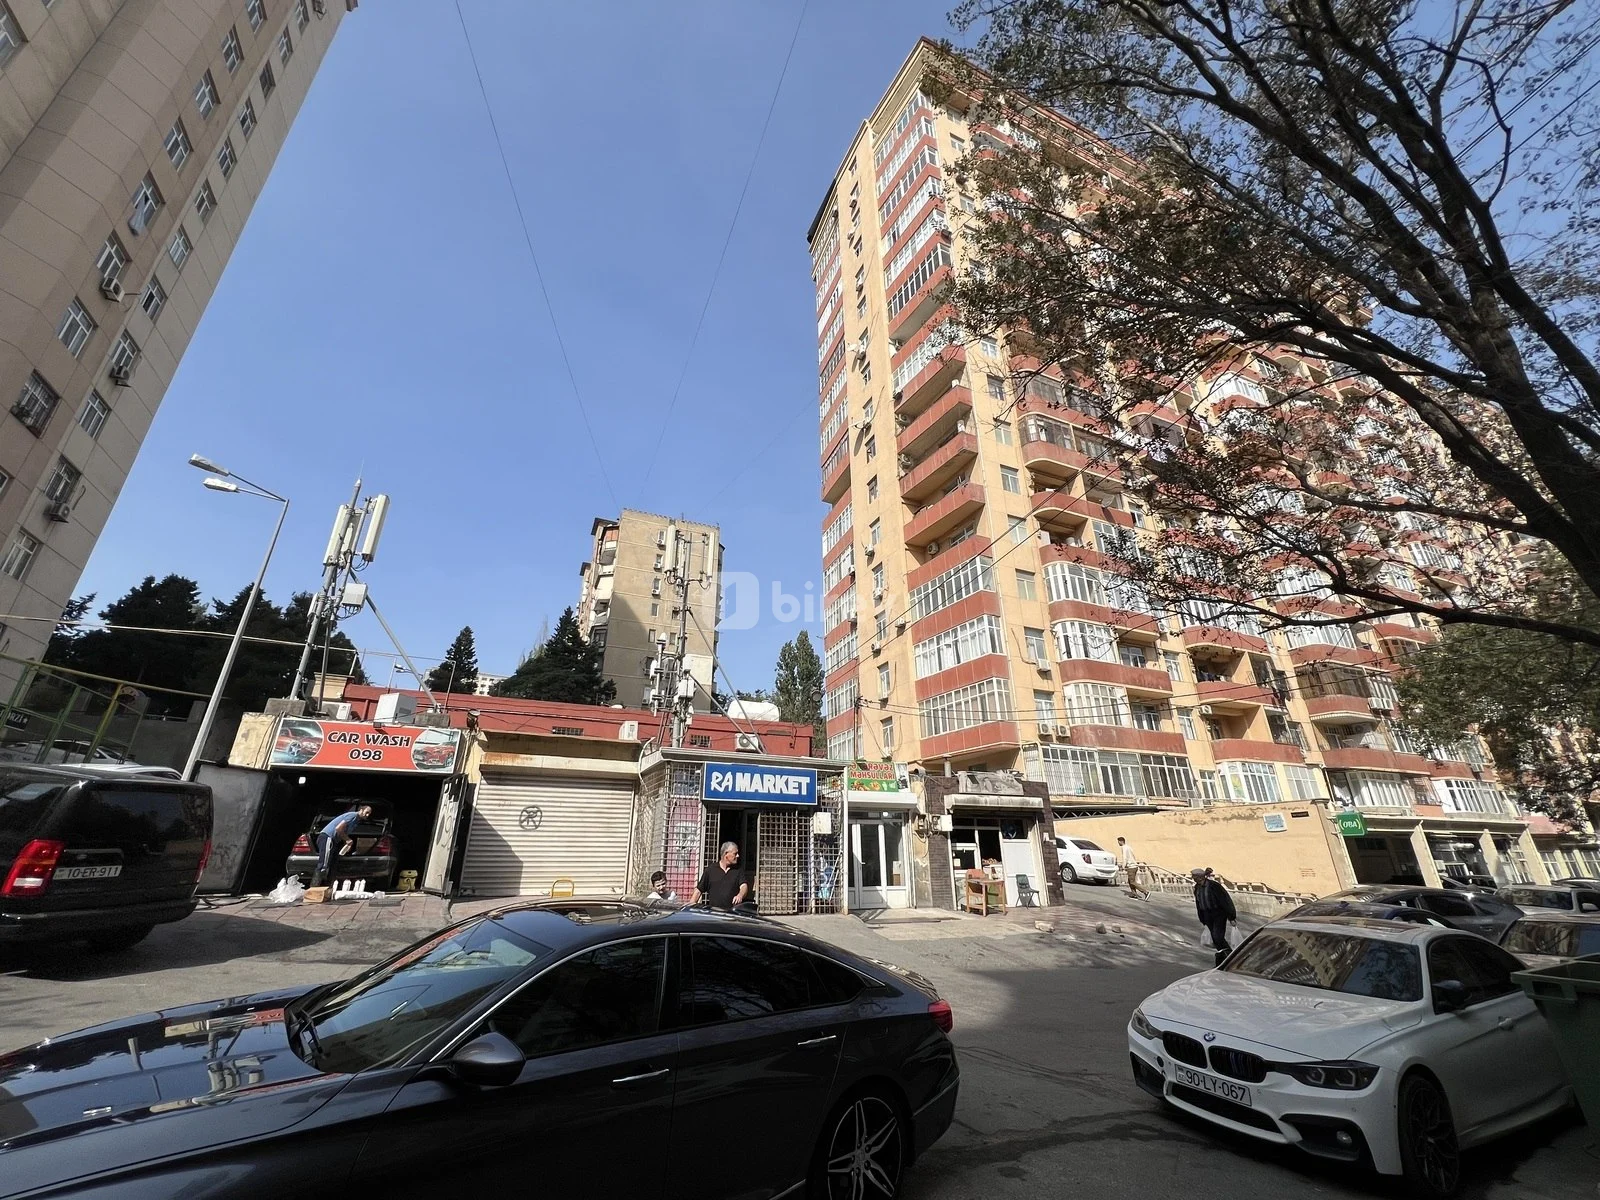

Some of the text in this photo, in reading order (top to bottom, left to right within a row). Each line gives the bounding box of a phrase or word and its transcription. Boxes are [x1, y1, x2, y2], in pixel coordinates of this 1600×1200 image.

[327, 731, 411, 747] CAR WASH
[348, 749, 383, 761] 098
[860, 762, 893, 772] ƏRƏVƏZ
[710, 771, 810, 795] RA MARKET
[67, 866, 119, 878] 10-ER-911
[1185, 1070, 1246, 1101] 90-LY-067
